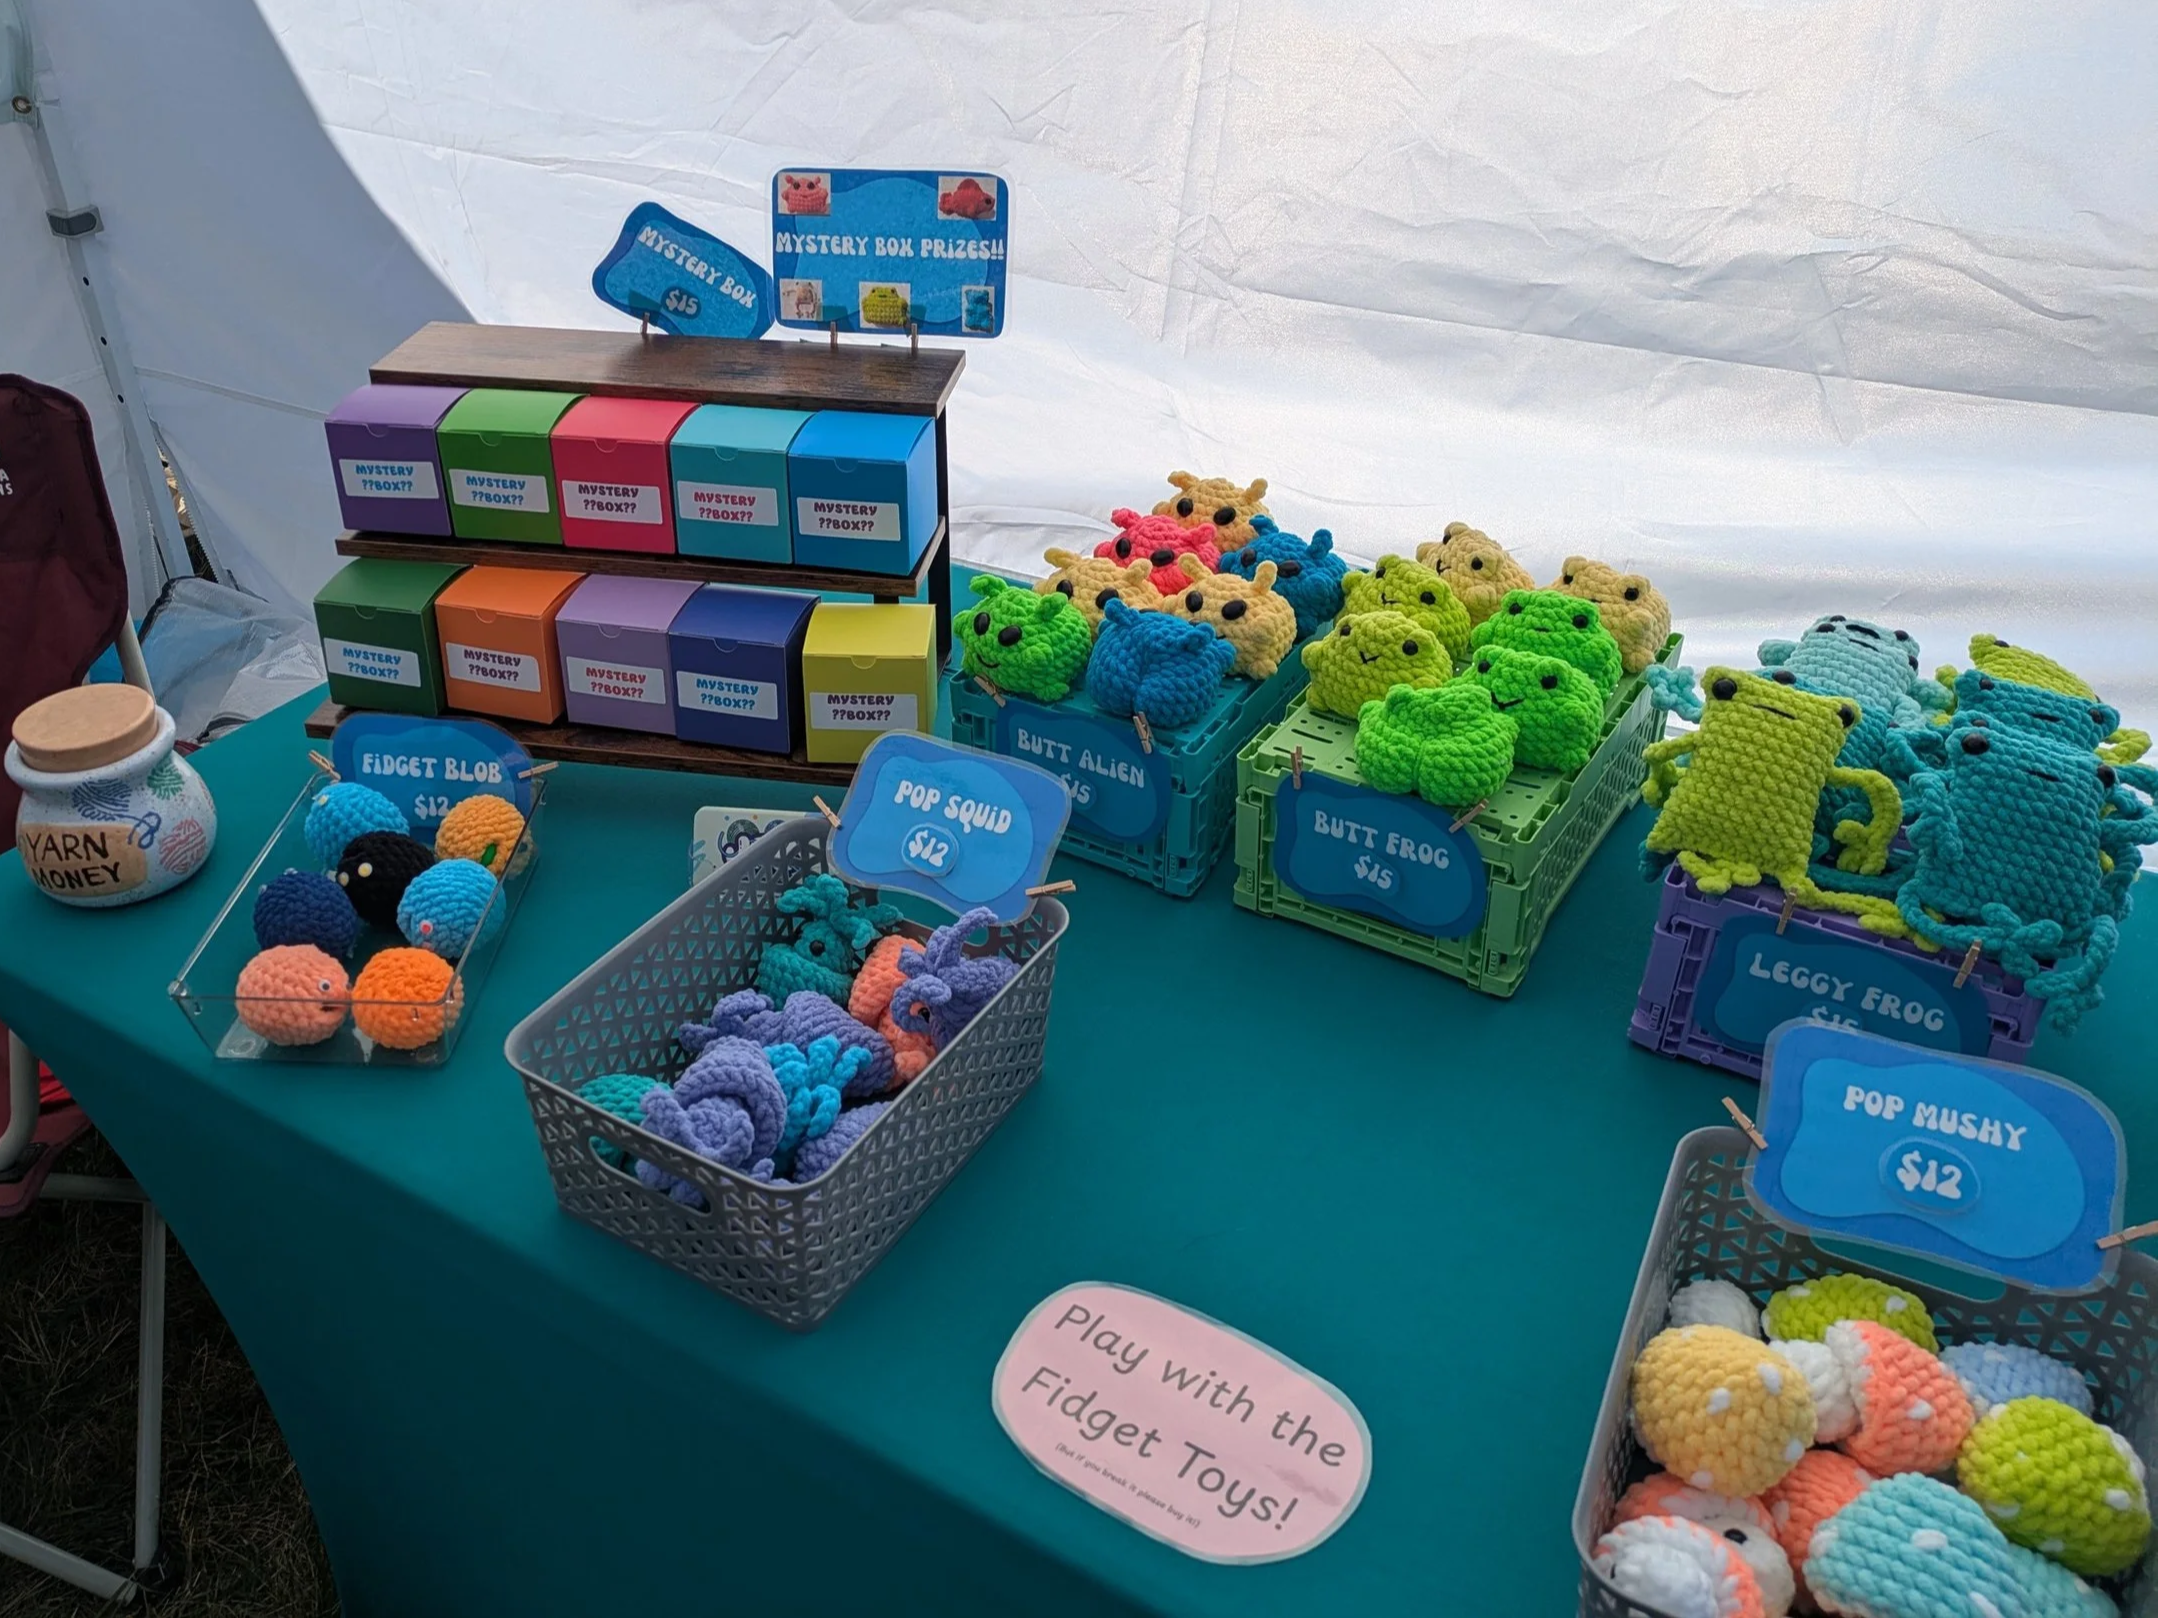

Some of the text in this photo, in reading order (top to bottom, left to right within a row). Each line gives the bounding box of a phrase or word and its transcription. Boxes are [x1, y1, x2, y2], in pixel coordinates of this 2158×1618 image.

[776, 231, 869, 256] MYSTERY
[875, 237, 914, 258] BOX
[638, 226, 756, 308] MYSTERY BOX
[665, 288, 698, 315] $15
[355, 464, 414, 477] MYSTERY
[361, 479, 413, 492] ??BOX??
[466, 475, 526, 490] MYSTERY
[578, 483, 639, 498] MYSTERY
[471, 490, 524, 506] ??BOX??
[583, 499, 637, 514] ??BOX??
[694, 491, 756, 507] MYSTERY
[698, 506, 753, 522] ??BOX??
[814, 502, 878, 516] MYSTERY
[818, 517, 874, 531] ??BOX??
[343, 647, 401, 665] MYSTERY
[463, 649, 521, 667] MYSTERY
[347, 662, 399, 680] ??BOX??
[468, 664, 519, 682] ??BOX??
[585, 666, 647, 684] MYSTERY
[590, 681, 644, 699] ??BOX??
[696, 678, 759, 696] MYSTERY
[700, 693, 755, 710] ??BOX??
[827, 694, 895, 706] MYSTERY
[832, 709, 891, 721] ??BOX??
[1018, 728, 1072, 764] BUTT
[444, 757, 502, 784] BLOB
[894, 780, 941, 813] POP
[414, 794, 450, 820] $12
[26, 832, 109, 863] YARN
[908, 829, 949, 867] $12
[1314, 810, 1449, 869] BUTT FROG
[32, 862, 121, 890] MONEY
[1354, 855, 1393, 890] $15
[1749, 952, 1944, 1031] LEGGY FROG
[1844, 1085, 2027, 1151] POP MUSHY
[1896, 1150, 1962, 1200] $12
[1054, 1304, 1346, 1467] Play with the
[1021, 1366, 1299, 1531] Fidget Toys!
[1083, 1459, 1101, 1473] you
[1102, 1467, 1127, 1488] break
[1137, 1488, 1167, 1509] please
[1167, 1504, 1184, 1521] buy
